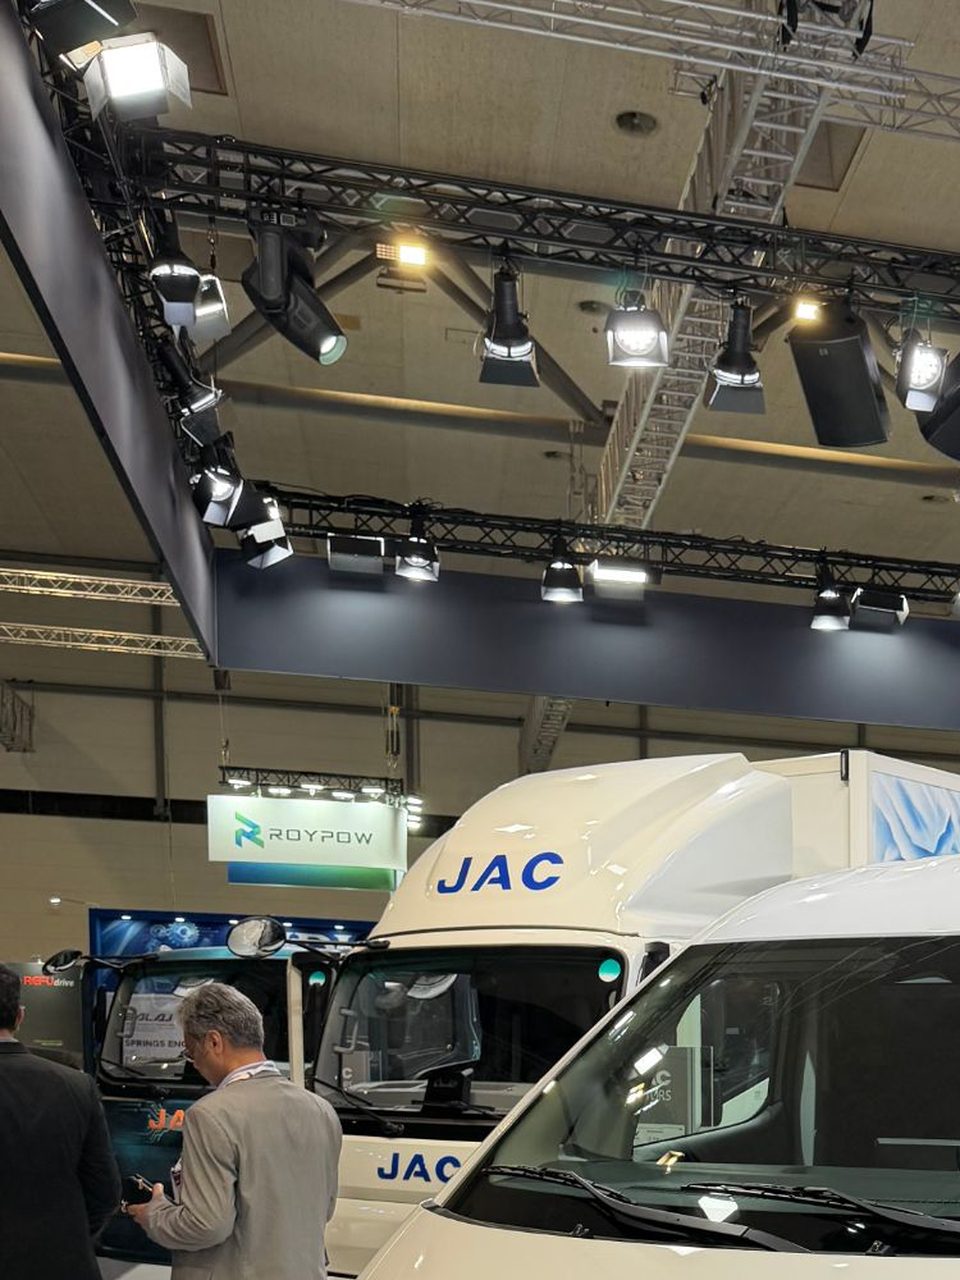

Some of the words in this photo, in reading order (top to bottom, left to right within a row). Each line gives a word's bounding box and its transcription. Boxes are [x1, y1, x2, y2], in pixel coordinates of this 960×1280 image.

[269, 828, 373, 845] ROYPOW
[437, 852, 564, 894] JAC
[148, 1108, 185, 1131] JA
[377, 1152, 461, 1184] JAC
